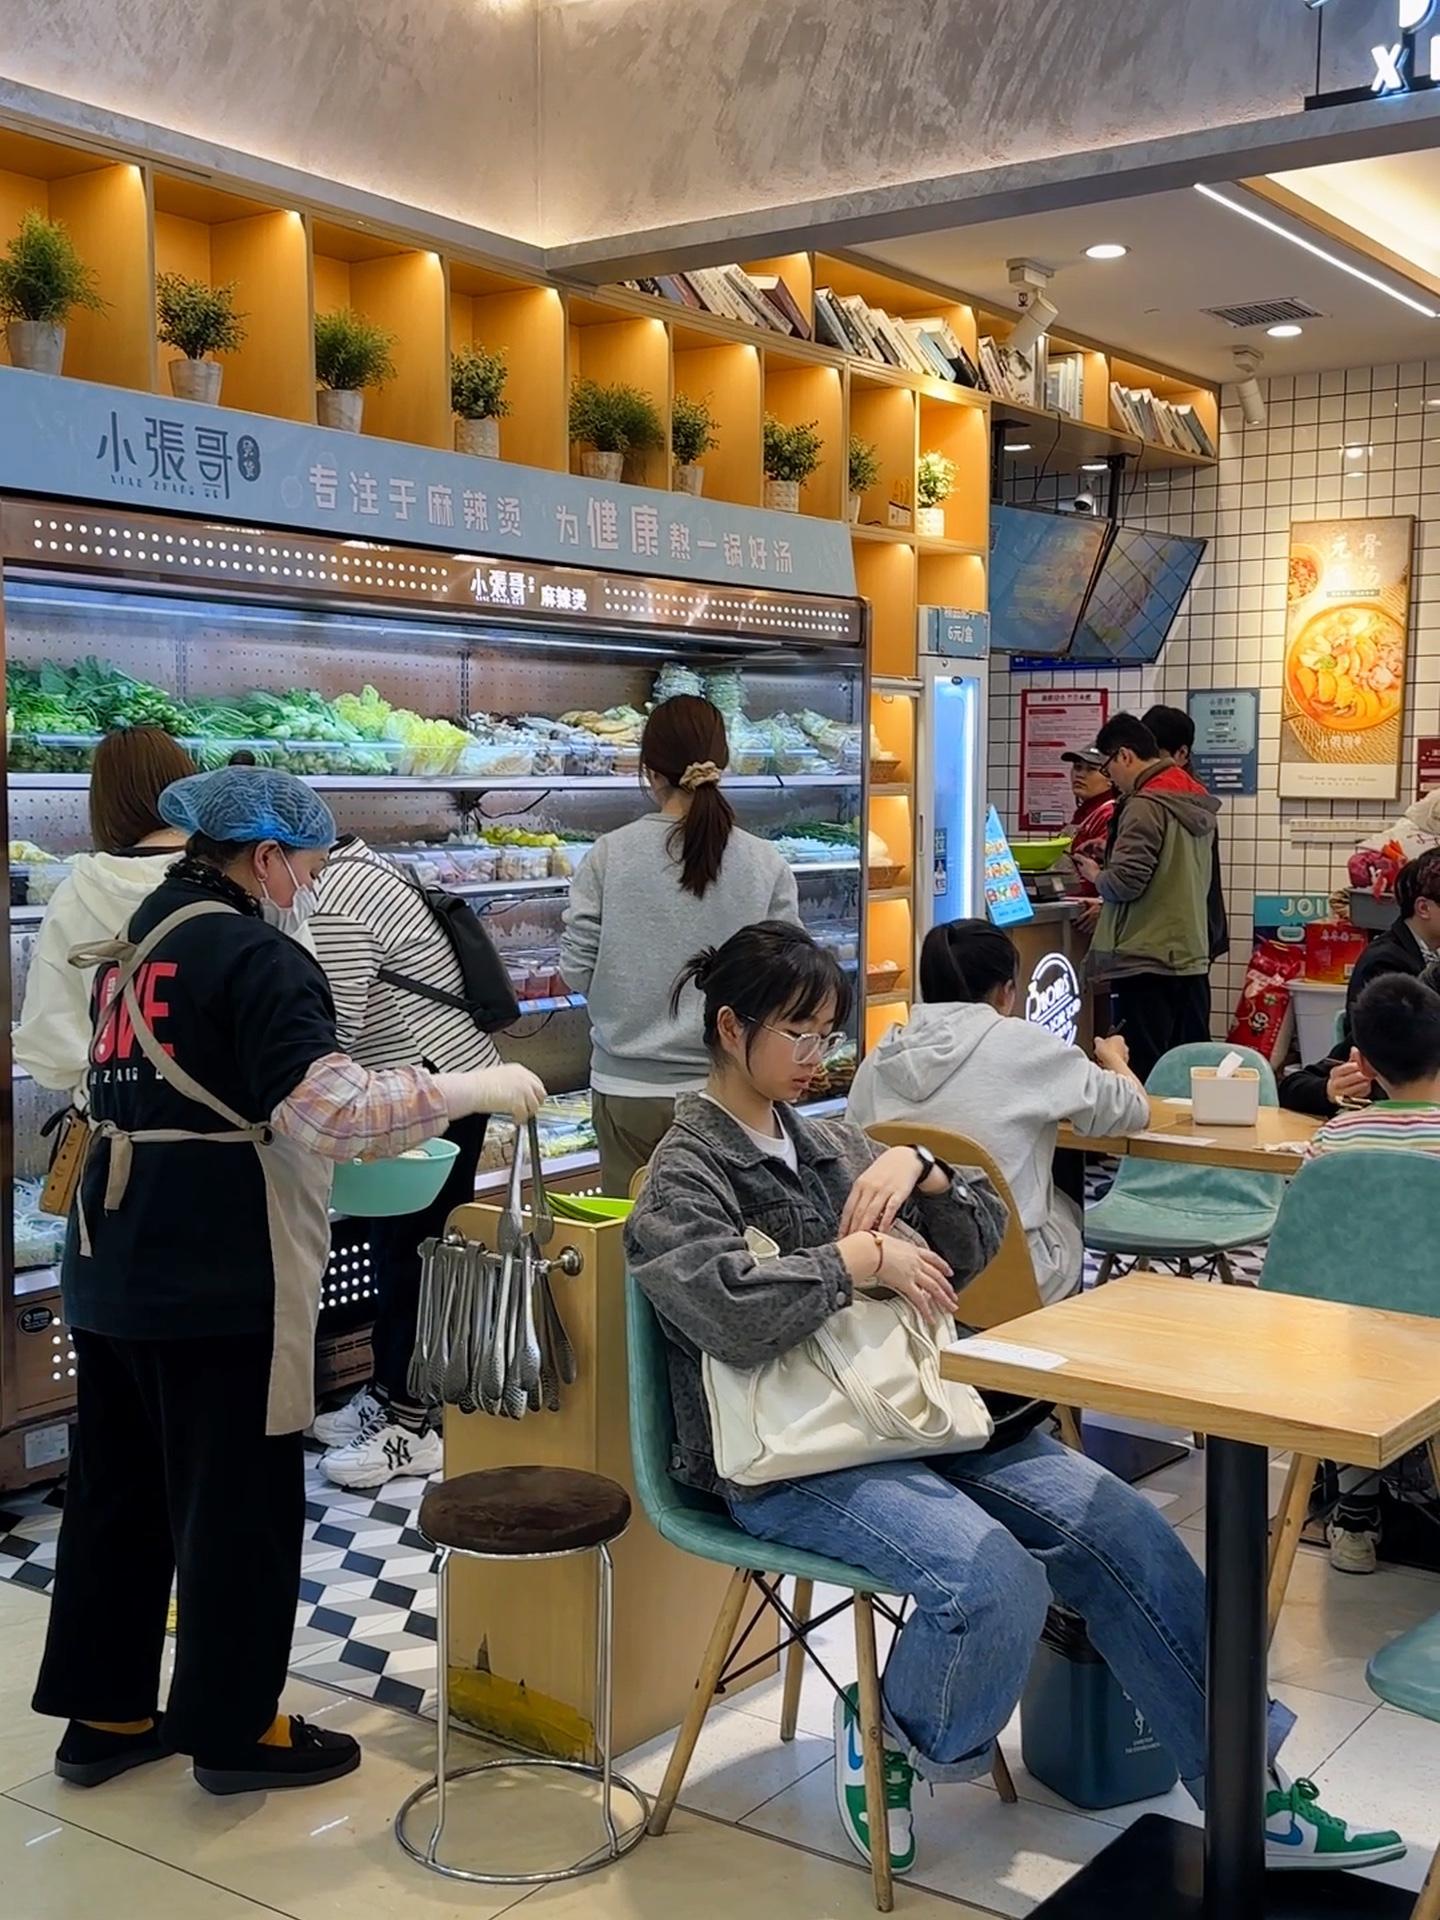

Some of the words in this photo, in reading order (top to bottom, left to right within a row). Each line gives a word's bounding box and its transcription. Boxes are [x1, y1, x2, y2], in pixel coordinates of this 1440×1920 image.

[96, 411, 232, 499] 小張哥
[309, 464, 521, 536] 专注于麻辣烫
[556, 497, 793, 574] 为健康熬一锅好汤
